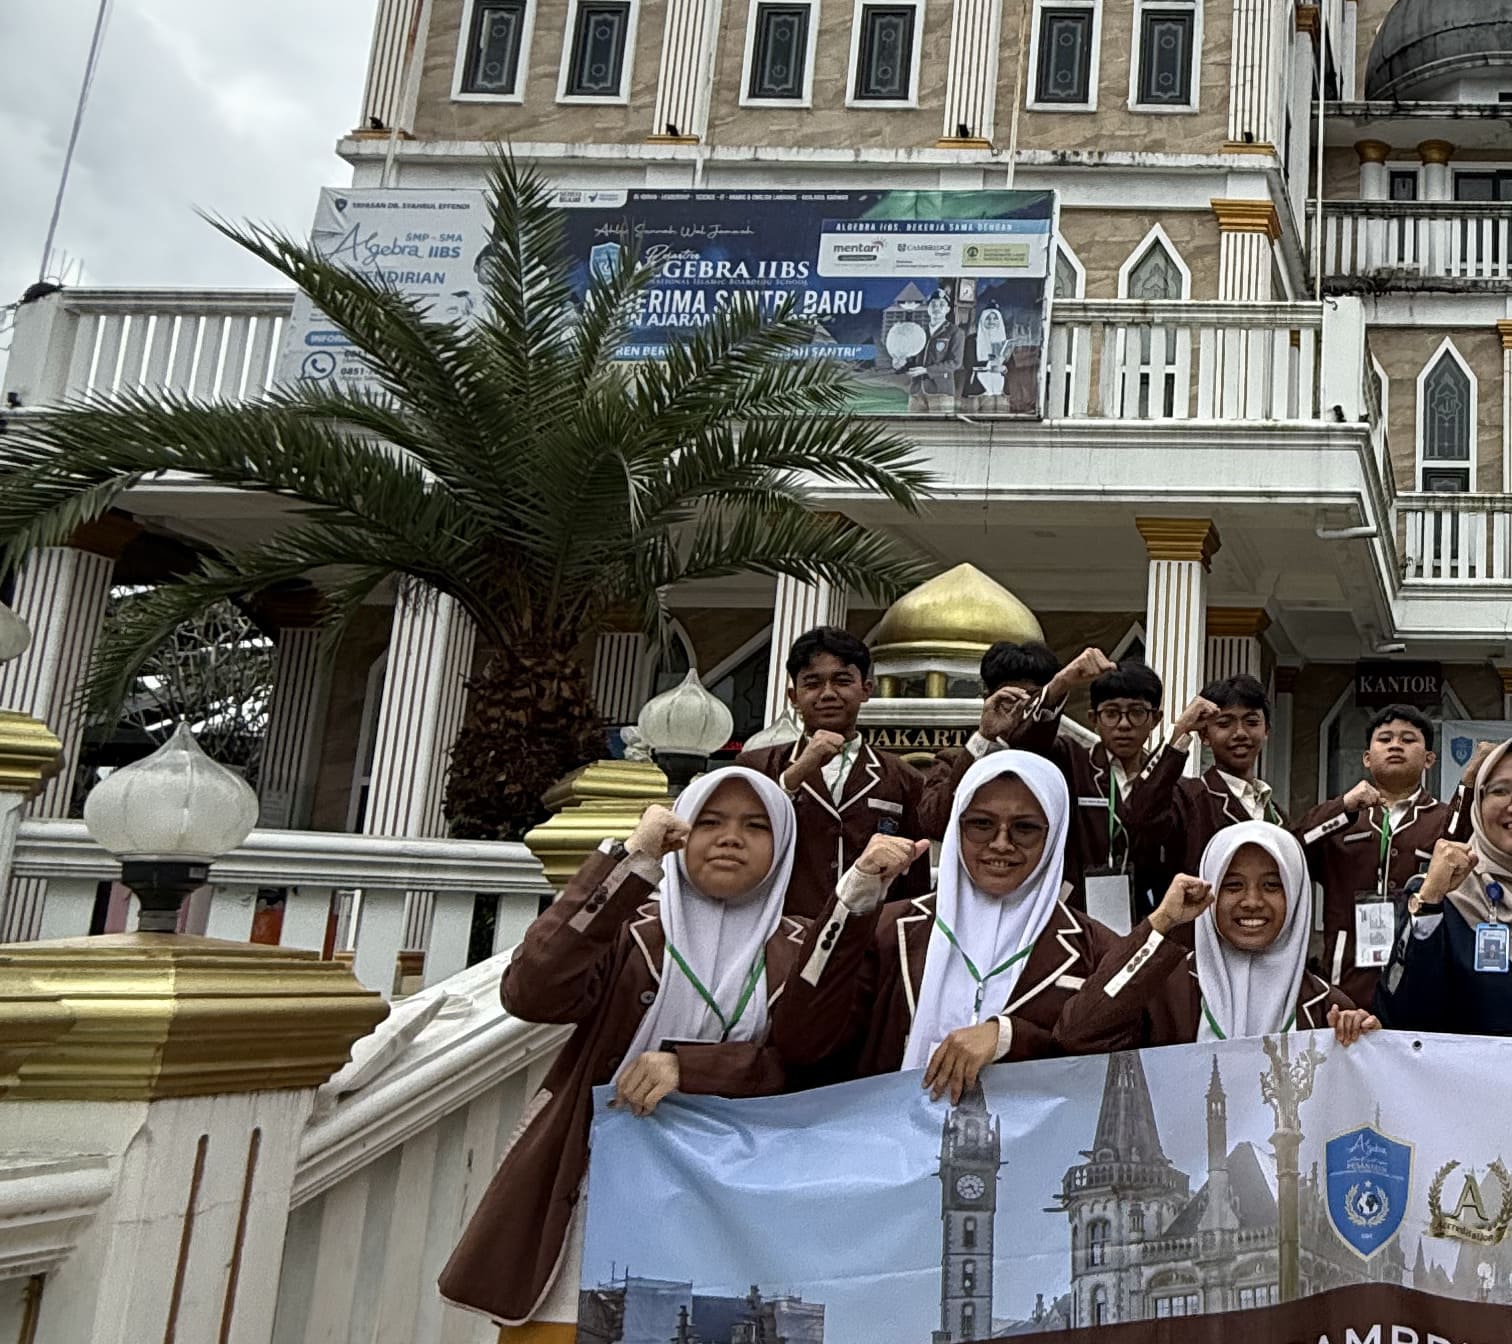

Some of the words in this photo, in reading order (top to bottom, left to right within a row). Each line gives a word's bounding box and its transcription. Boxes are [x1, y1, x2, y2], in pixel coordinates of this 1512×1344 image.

[405, 233, 429, 242] SMP
[438, 233, 463, 242] SMA
[428, 247, 462, 258] IIBS
[834, 243, 880, 253] mentari
[758, 260, 810, 278] IIBS
[803, 290, 863, 314] BARU
[1360, 675, 1438, 693] KANTOR
